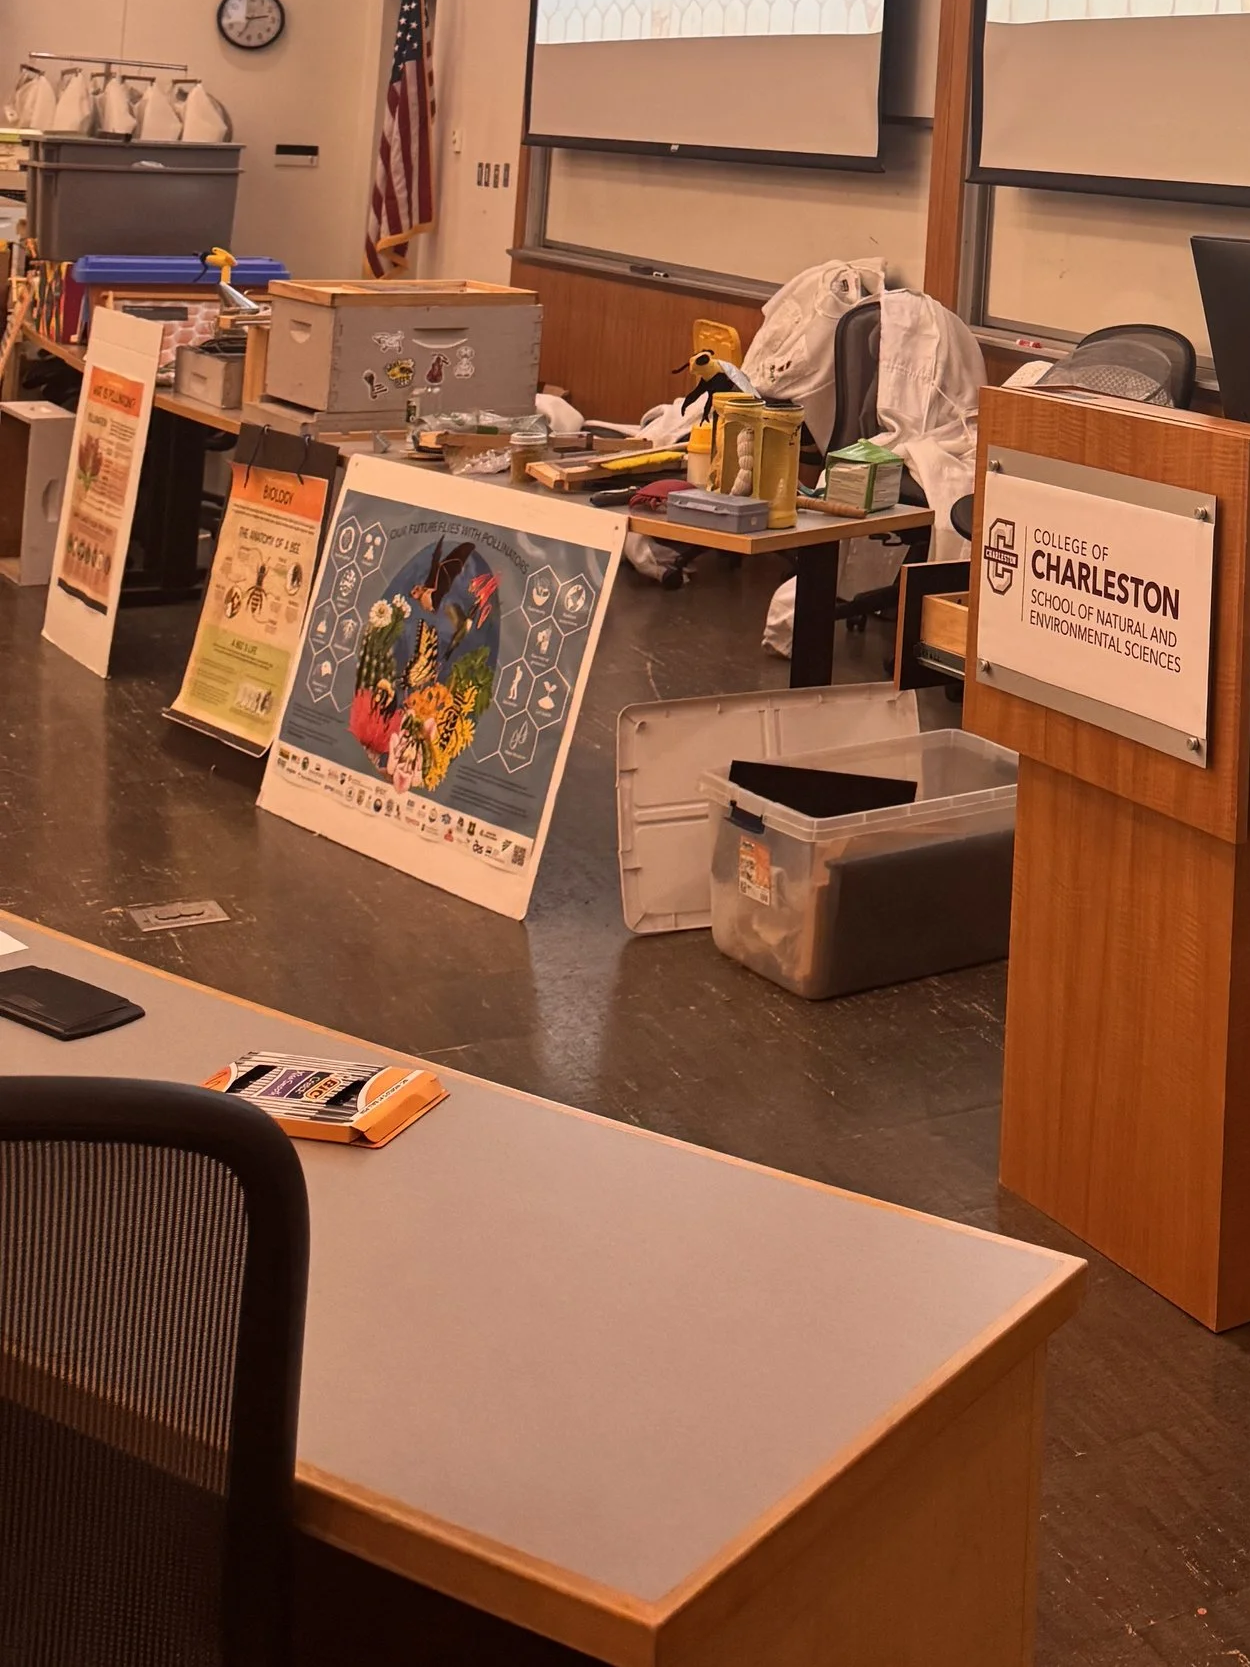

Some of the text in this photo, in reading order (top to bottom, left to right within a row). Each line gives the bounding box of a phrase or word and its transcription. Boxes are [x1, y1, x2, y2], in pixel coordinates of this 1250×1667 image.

[264, 484, 294, 505] BIOLOGY
[481, 532, 529, 575] POLLINATORS
[985, 549, 1017, 565] CHARLESTON
[1034, 528, 1109, 562] COLLEGE OF
[1031, 550, 1179, 620] CHARLESTON
[1031, 589, 1177, 648] SCHOOL OF NATURAL AND
[1030, 610, 1181, 673] ENVIRONMENTAL SCIENCES
[308, 1078, 339, 1098] BIC
